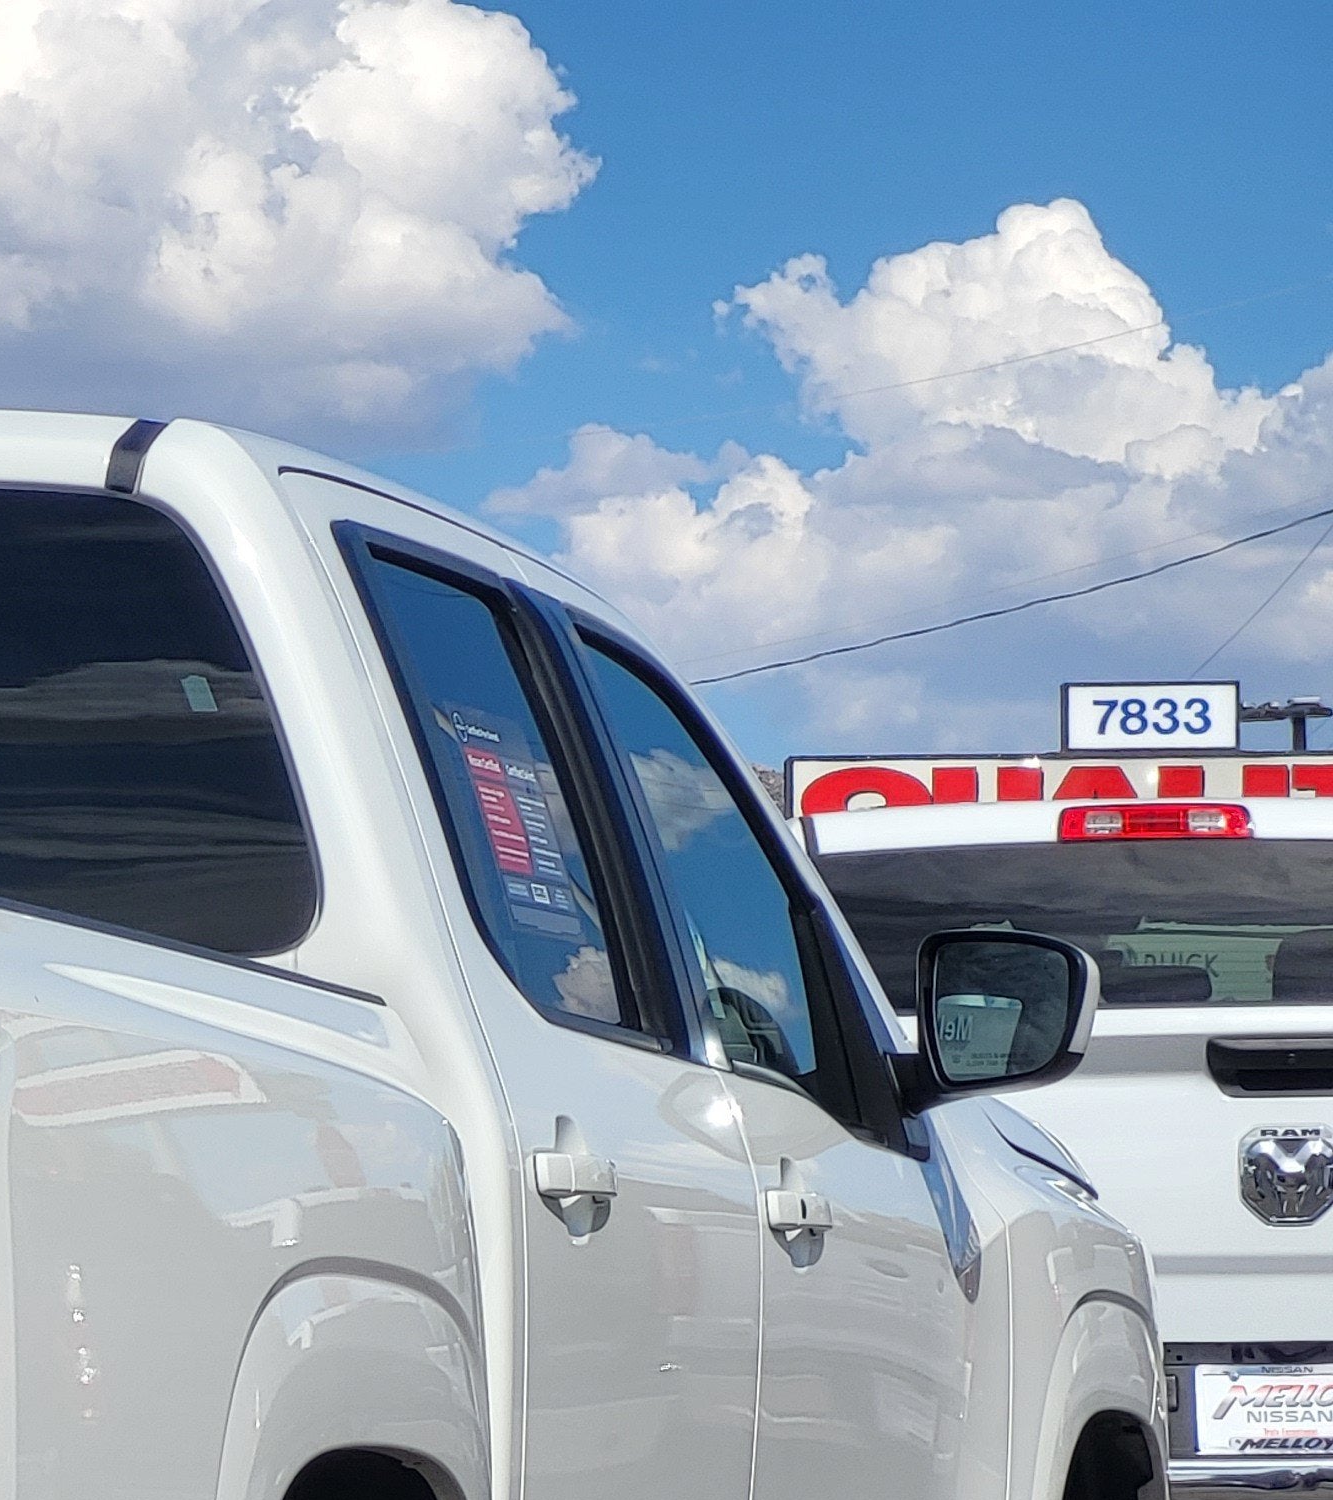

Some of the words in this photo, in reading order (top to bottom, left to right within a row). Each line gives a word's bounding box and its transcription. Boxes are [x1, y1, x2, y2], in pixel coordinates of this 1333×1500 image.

[1092, 697, 1213, 735] 7833
[1259, 1128, 1321, 1137] RAM
[1260, 1366, 1314, 1374] NISSAN
[1246, 1410, 1333, 1423] NISSAN
